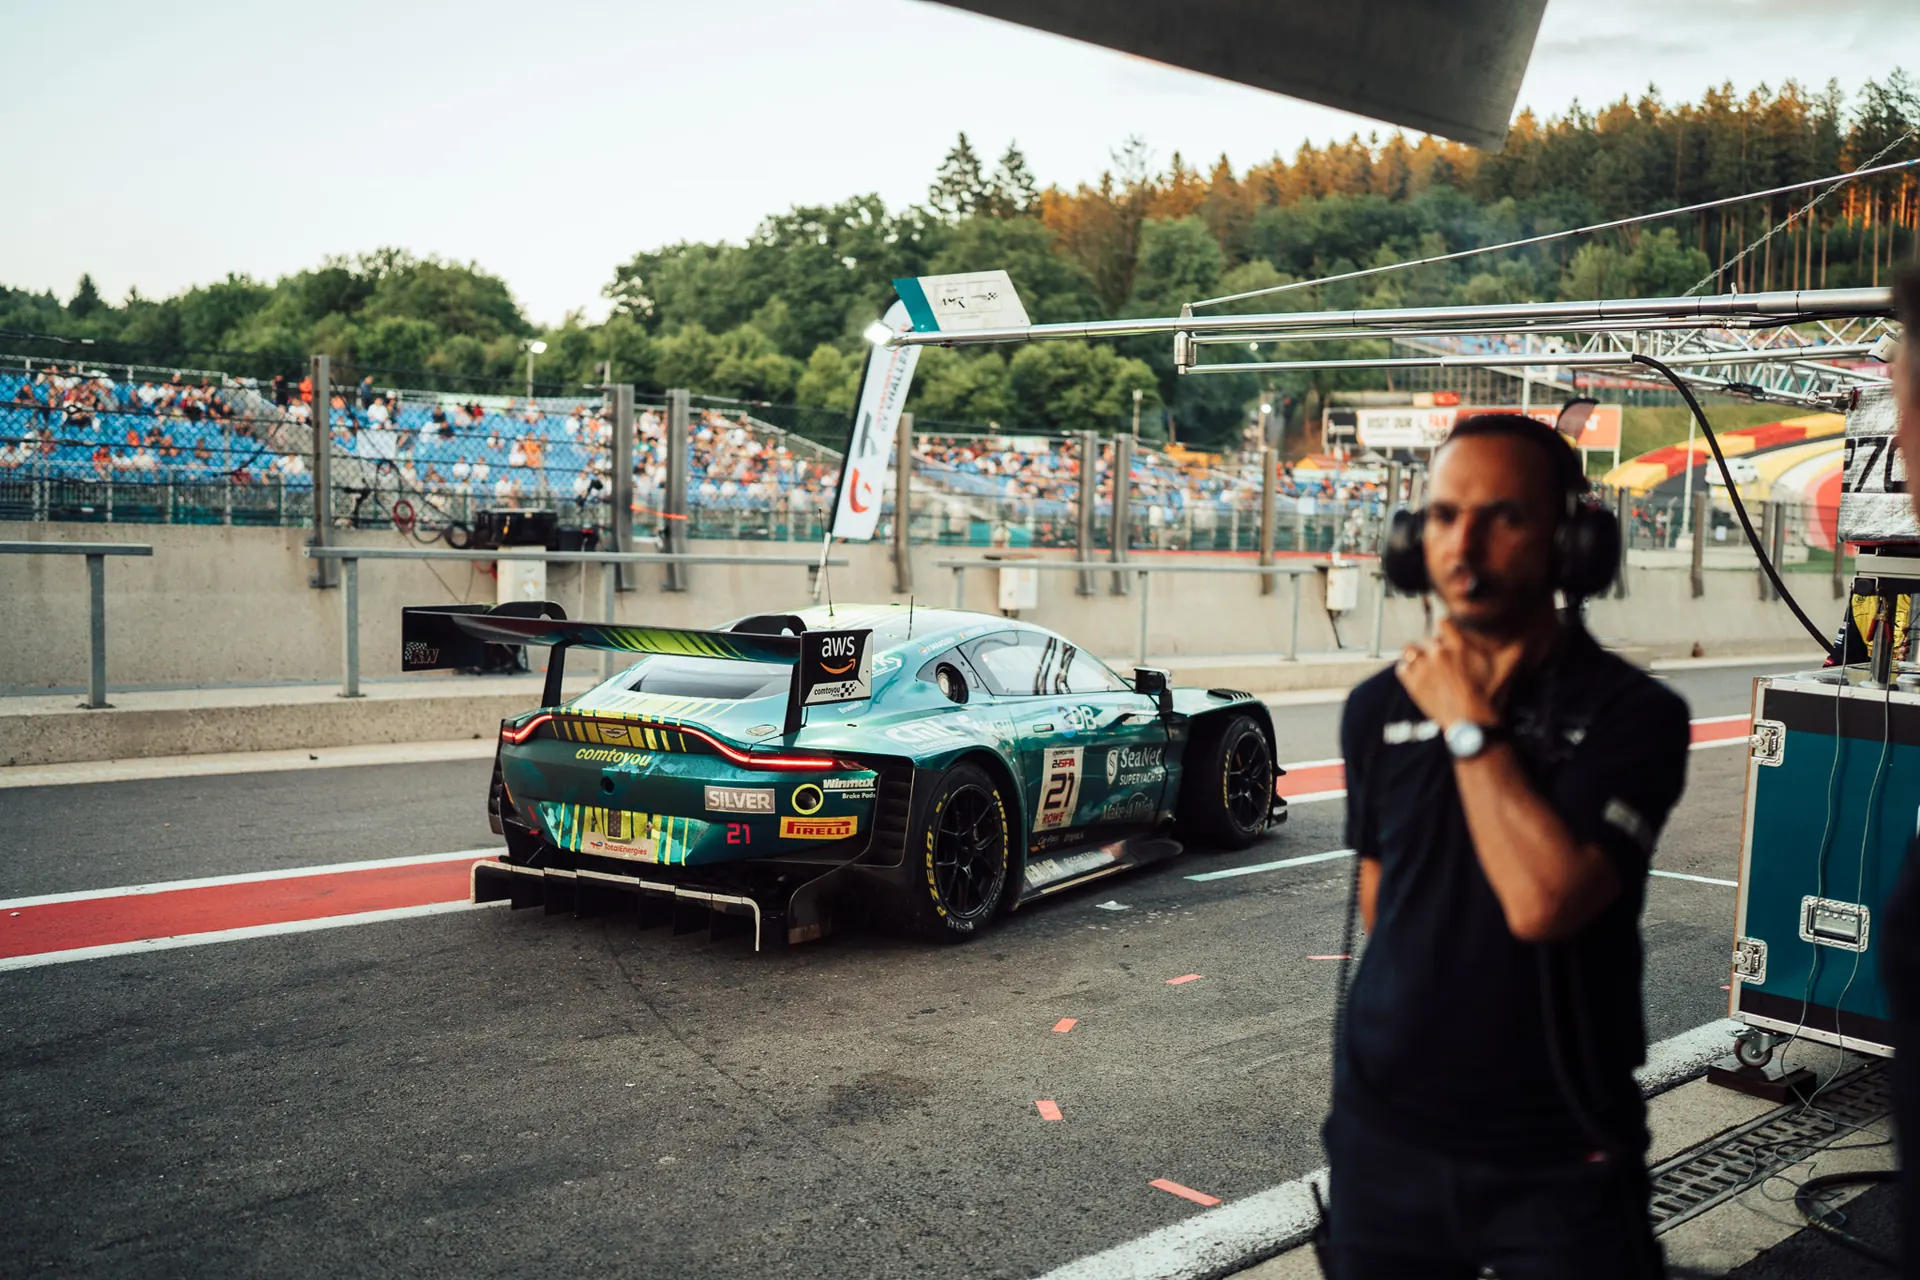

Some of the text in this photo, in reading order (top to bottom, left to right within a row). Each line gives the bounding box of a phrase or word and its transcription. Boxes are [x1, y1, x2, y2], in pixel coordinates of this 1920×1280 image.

[1428, 414, 1448, 428] FAN
[821, 636, 855, 657] aws
[814, 686, 840, 697] comtoyou
[575, 748, 652, 767] comtoyou
[1120, 747, 1162, 769] SeaNet
[1119, 772, 1163, 787] SUPERYACHTS
[1043, 772, 1075, 810] 21
[708, 790, 771, 810] SILVER
[1042, 811, 1065, 825] ROWE
[726, 823, 751, 844] 21
[787, 821, 852, 835] PIRELLI
[604, 843, 647, 856] TotalEnergies
